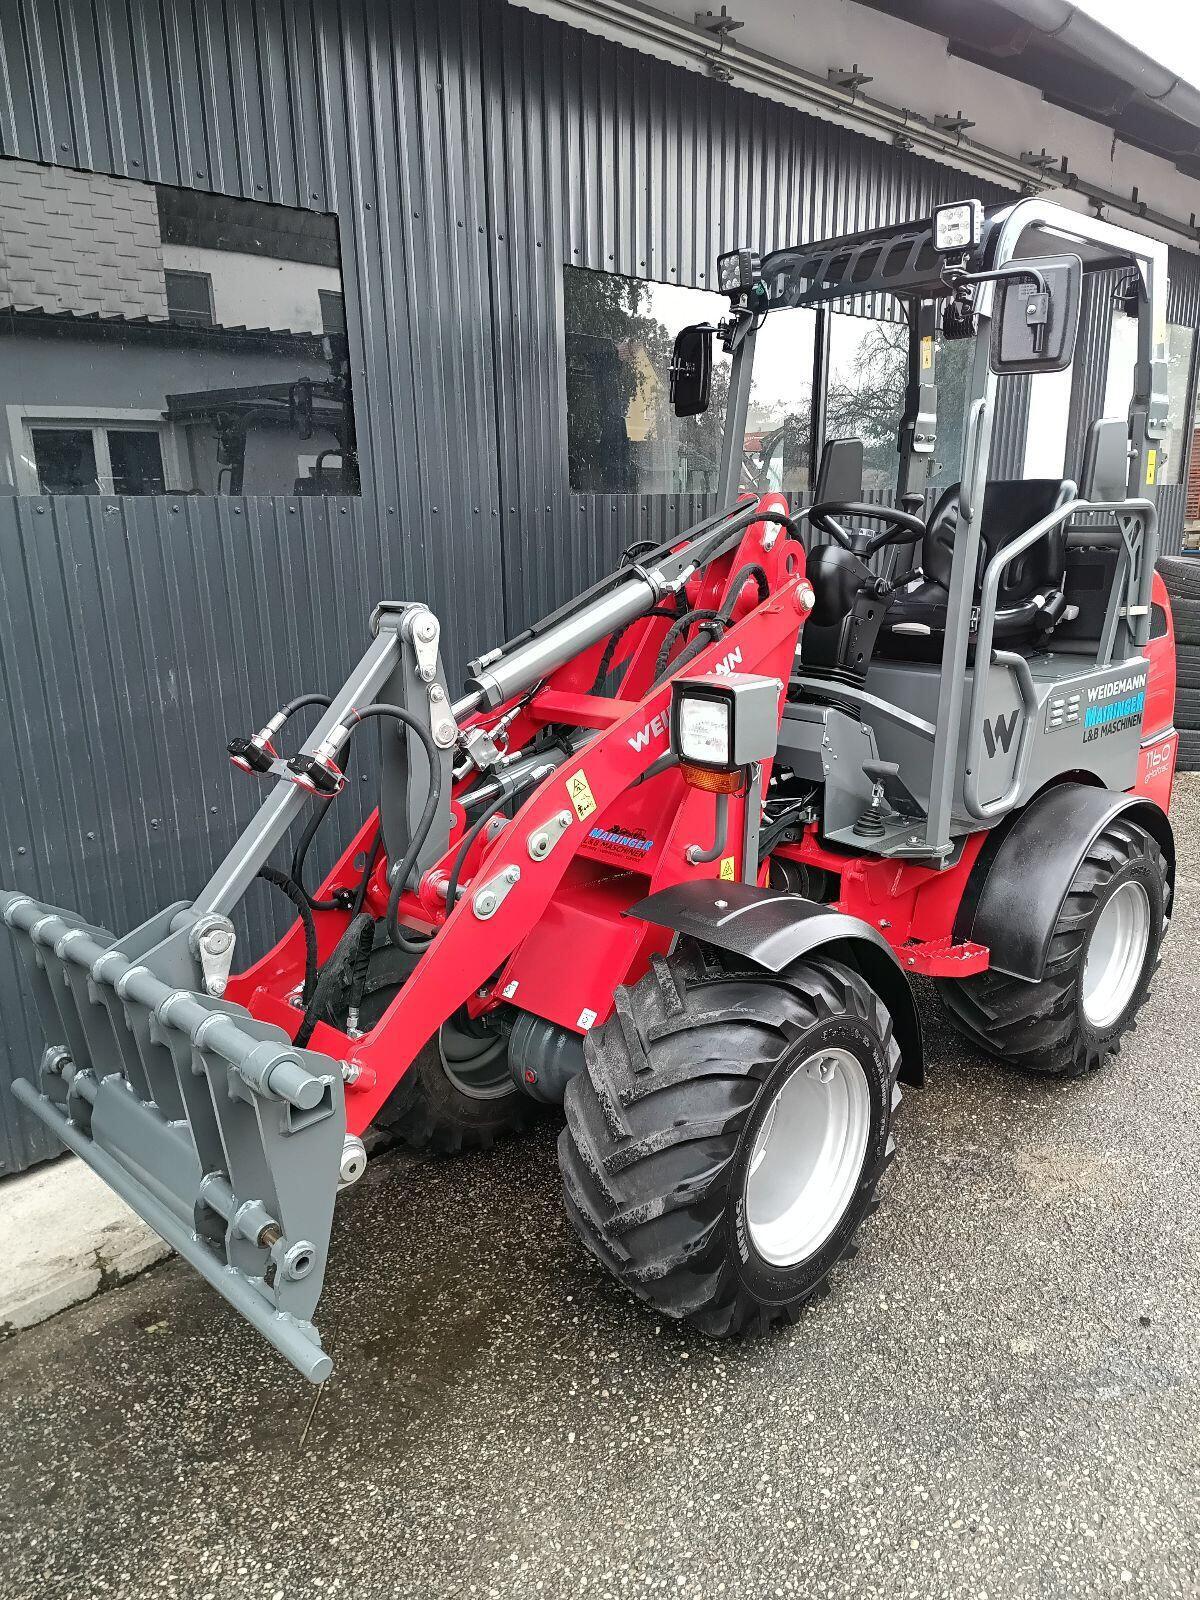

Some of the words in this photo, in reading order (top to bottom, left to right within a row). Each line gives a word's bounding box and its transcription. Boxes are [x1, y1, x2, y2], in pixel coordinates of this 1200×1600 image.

[1087, 673, 1147, 702] WEIDEMANN
[1084, 691, 1145, 729] MAIRINGER
[983, 708, 1020, 759] W
[1082, 727, 1099, 743] L&B
[1100, 712, 1143, 737] MASCHINEN
[1146, 743, 1171, 769] 1160
[588, 827, 654, 852] MAIRINGER
[601, 840, 647, 859] MASCHINEN
